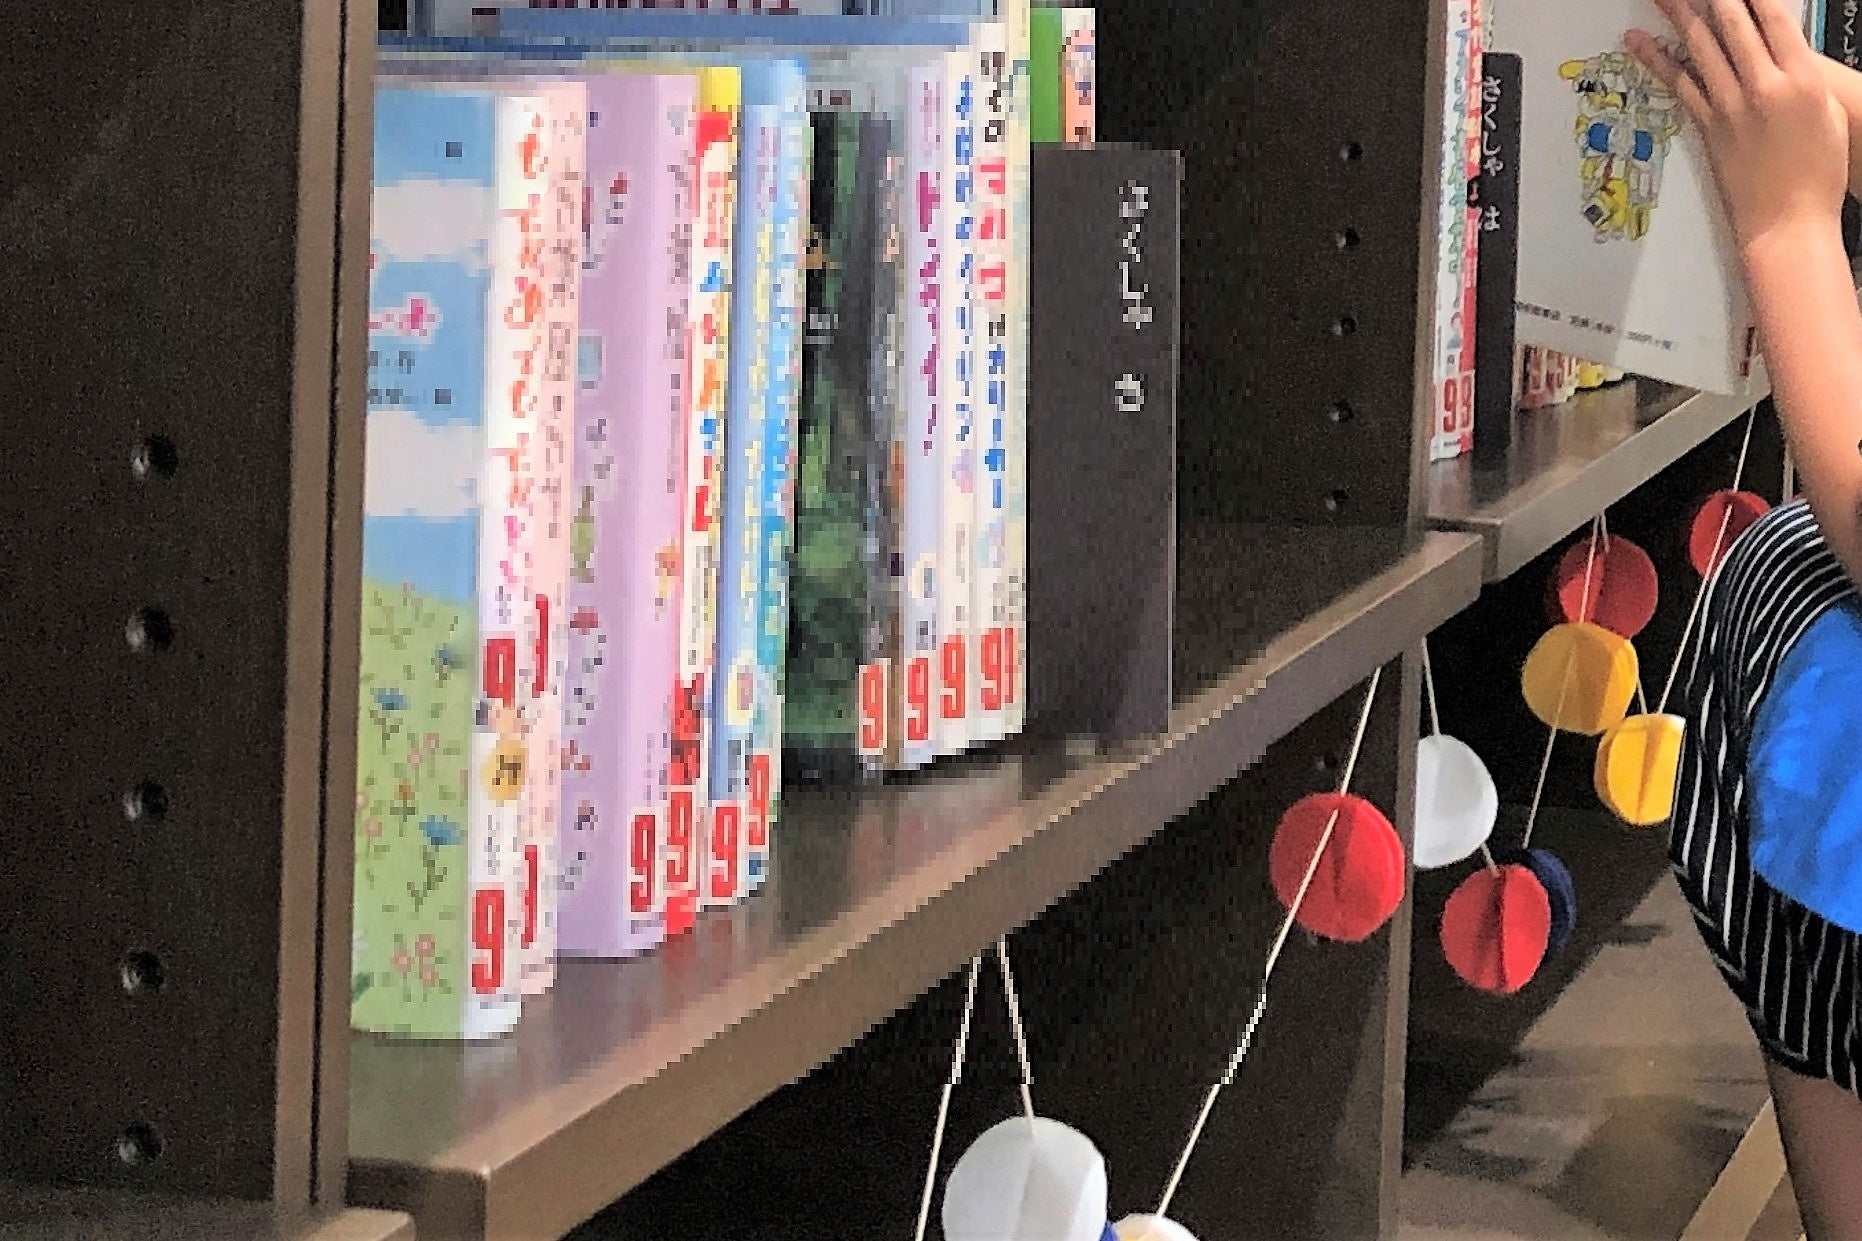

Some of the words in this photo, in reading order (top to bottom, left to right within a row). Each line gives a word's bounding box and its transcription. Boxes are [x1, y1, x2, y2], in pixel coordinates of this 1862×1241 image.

[1482, 75, 1504, 177] さくしゃ
[1119, 179, 1153, 330] さくしゃ
[1479, 205, 1501, 231] は
[1443, 378, 1457, 433] 9
[862, 664, 884, 749] 9
[907, 657, 929, 741] 9
[939, 634, 966, 718] 9
[667, 791, 693, 883] 9
[748, 754, 770, 846] 9
[630, 814, 656, 913] 9
[711, 806, 739, 898] 9
[471, 889, 505, 994] 9
